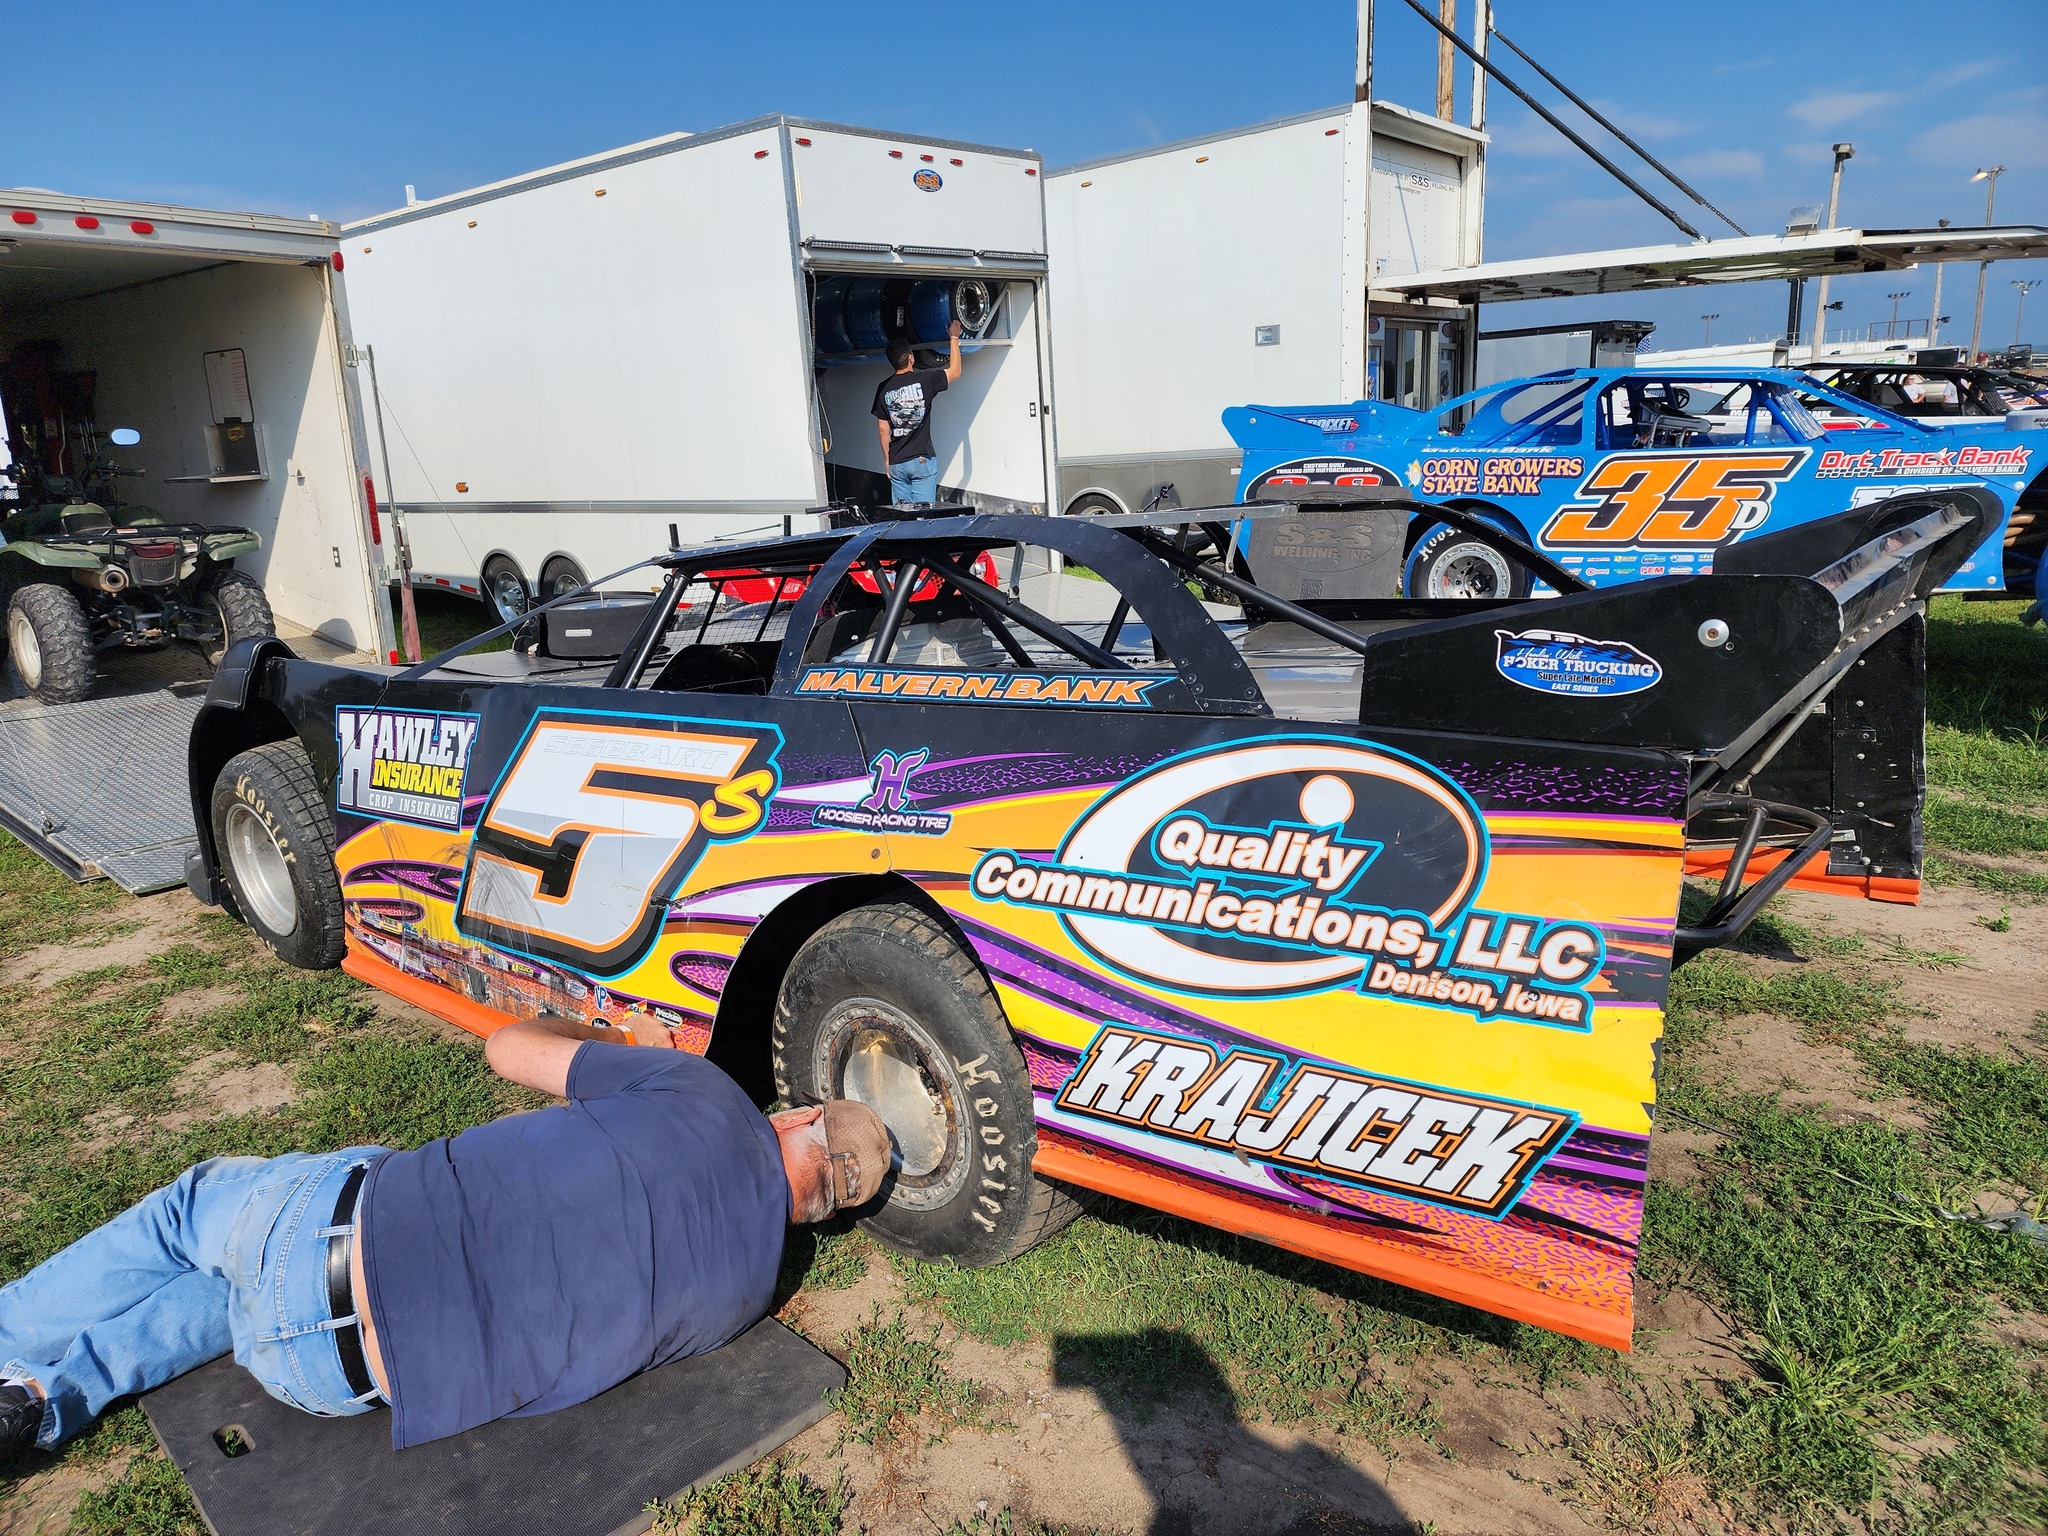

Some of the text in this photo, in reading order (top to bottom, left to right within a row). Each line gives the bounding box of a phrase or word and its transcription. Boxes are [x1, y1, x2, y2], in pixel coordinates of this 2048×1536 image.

[1411, 174, 1430, 188] S&S
[1422, 458, 1583, 477] CORN GROWERS
[1819, 444, 2033, 469] Dirt Track Bank
[1904, 467, 1941, 475] DIVISION
[1995, 465, 2020, 473] BANK
[1422, 476, 1541, 494] STATE BANK
[1277, 522, 1374, 548] S&S
[1537, 671, 1615, 685] Super Late Models
[1563, 660, 1655, 678] TRUCKING
[1551, 683, 1600, 693] EAST SERIES
[339, 713, 476, 806] HAWLEY
[544, 735, 728, 769] SEGEBART
[372, 759, 463, 798] INSURANCE
[369, 793, 457, 820] CROP INSURANCE
[818, 808, 949, 829] HOOSIER RACING TIRE
[1160, 819, 1367, 891] Quality
[976, 855, 1596, 980] Communications, LLC
[1368, 962, 1584, 1022] Denison, Iowa
[1068, 1031, 1548, 1205] KRAJICEK
